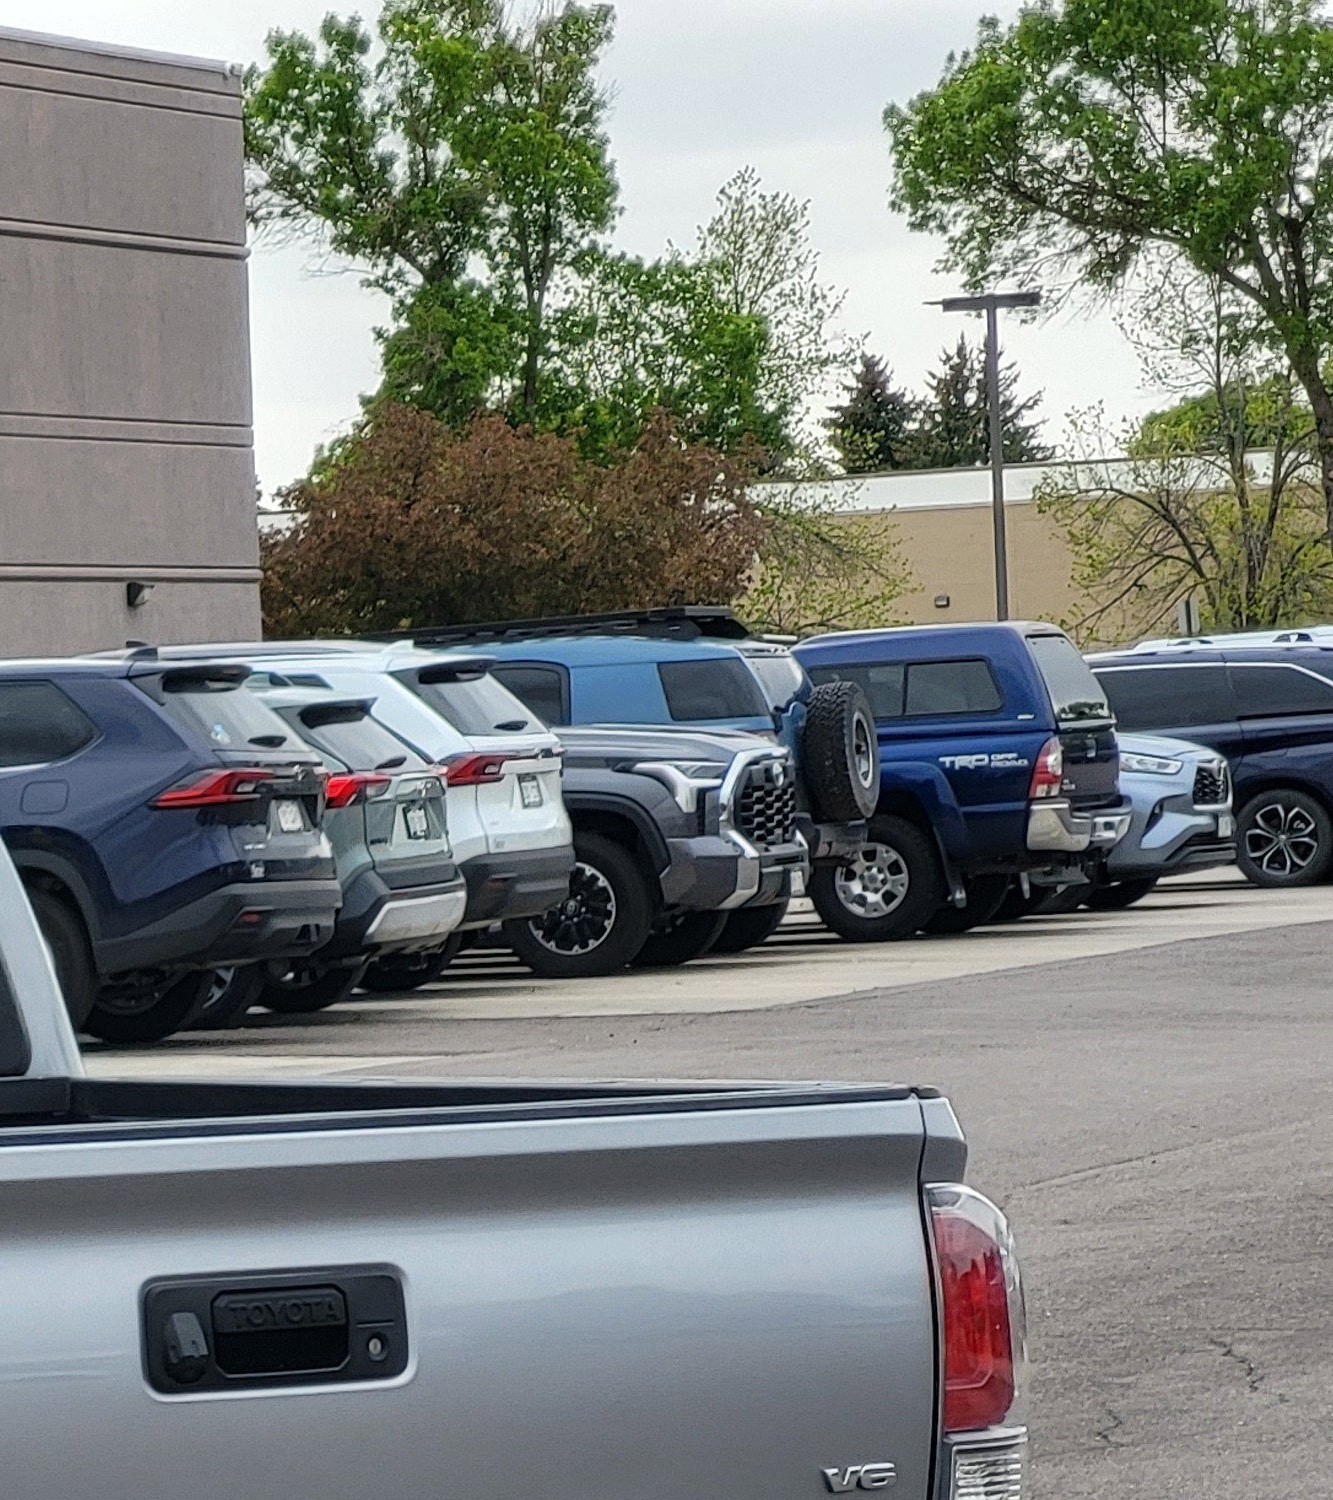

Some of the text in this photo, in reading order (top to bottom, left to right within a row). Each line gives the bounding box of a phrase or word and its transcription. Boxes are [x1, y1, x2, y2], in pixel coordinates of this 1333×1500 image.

[938, 754, 989, 770] TRD
[229, 1300, 341, 1326] TOYOTA
[820, 1461, 897, 1492] V6
